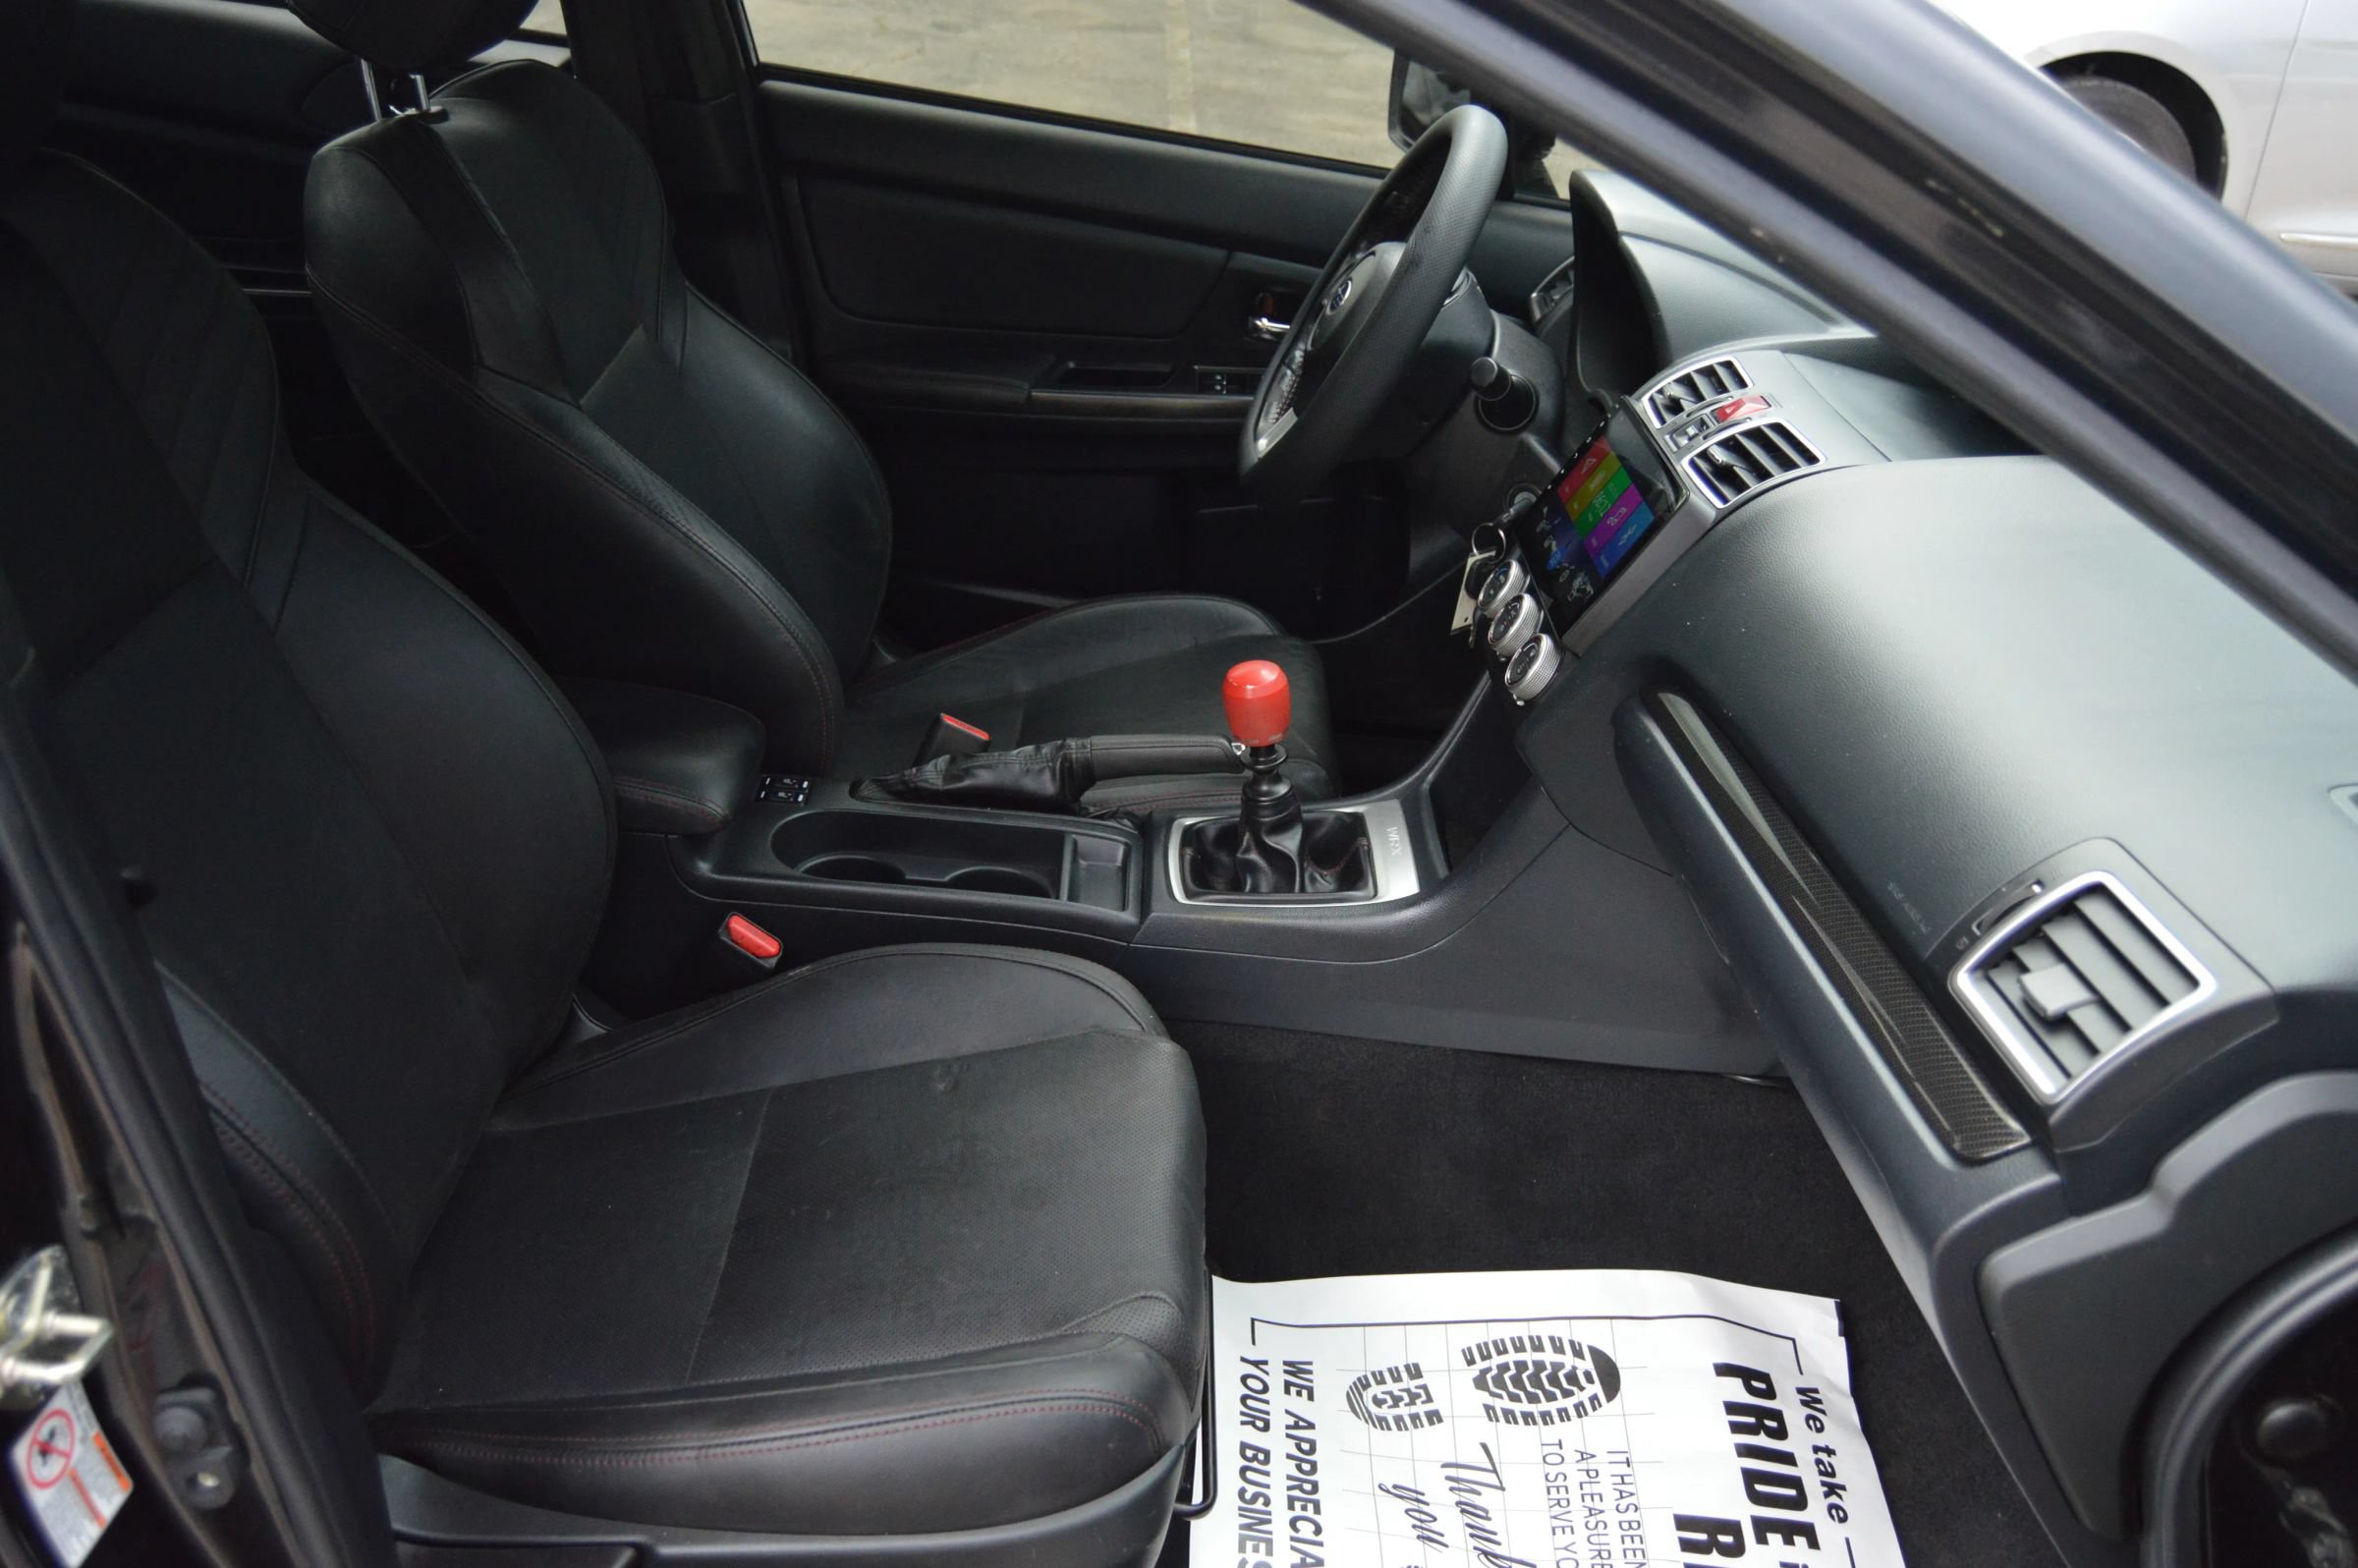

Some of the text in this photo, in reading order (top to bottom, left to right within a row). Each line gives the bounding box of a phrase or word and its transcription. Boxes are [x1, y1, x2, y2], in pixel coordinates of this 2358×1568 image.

[1386, 826, 1402, 857] WRX
[1239, 1356, 1271, 1432] YOUR
[1282, 1360, 1325, 1568] WE APPRECIA
[1541, 1439, 1565, 1466] TO
[1574, 1449, 1597, 1463] A
[1606, 1451, 1631, 1468] IT
[1712, 1362, 1821, 1551] PRIDE
[1795, 1386, 1849, 1524] We take
[1377, 1483, 1450, 1553] you
[1440, 1441, 1538, 1568] Thank
[1545, 1472, 1575, 1537] SERVE
[1610, 1474, 1639, 1514] HAS
